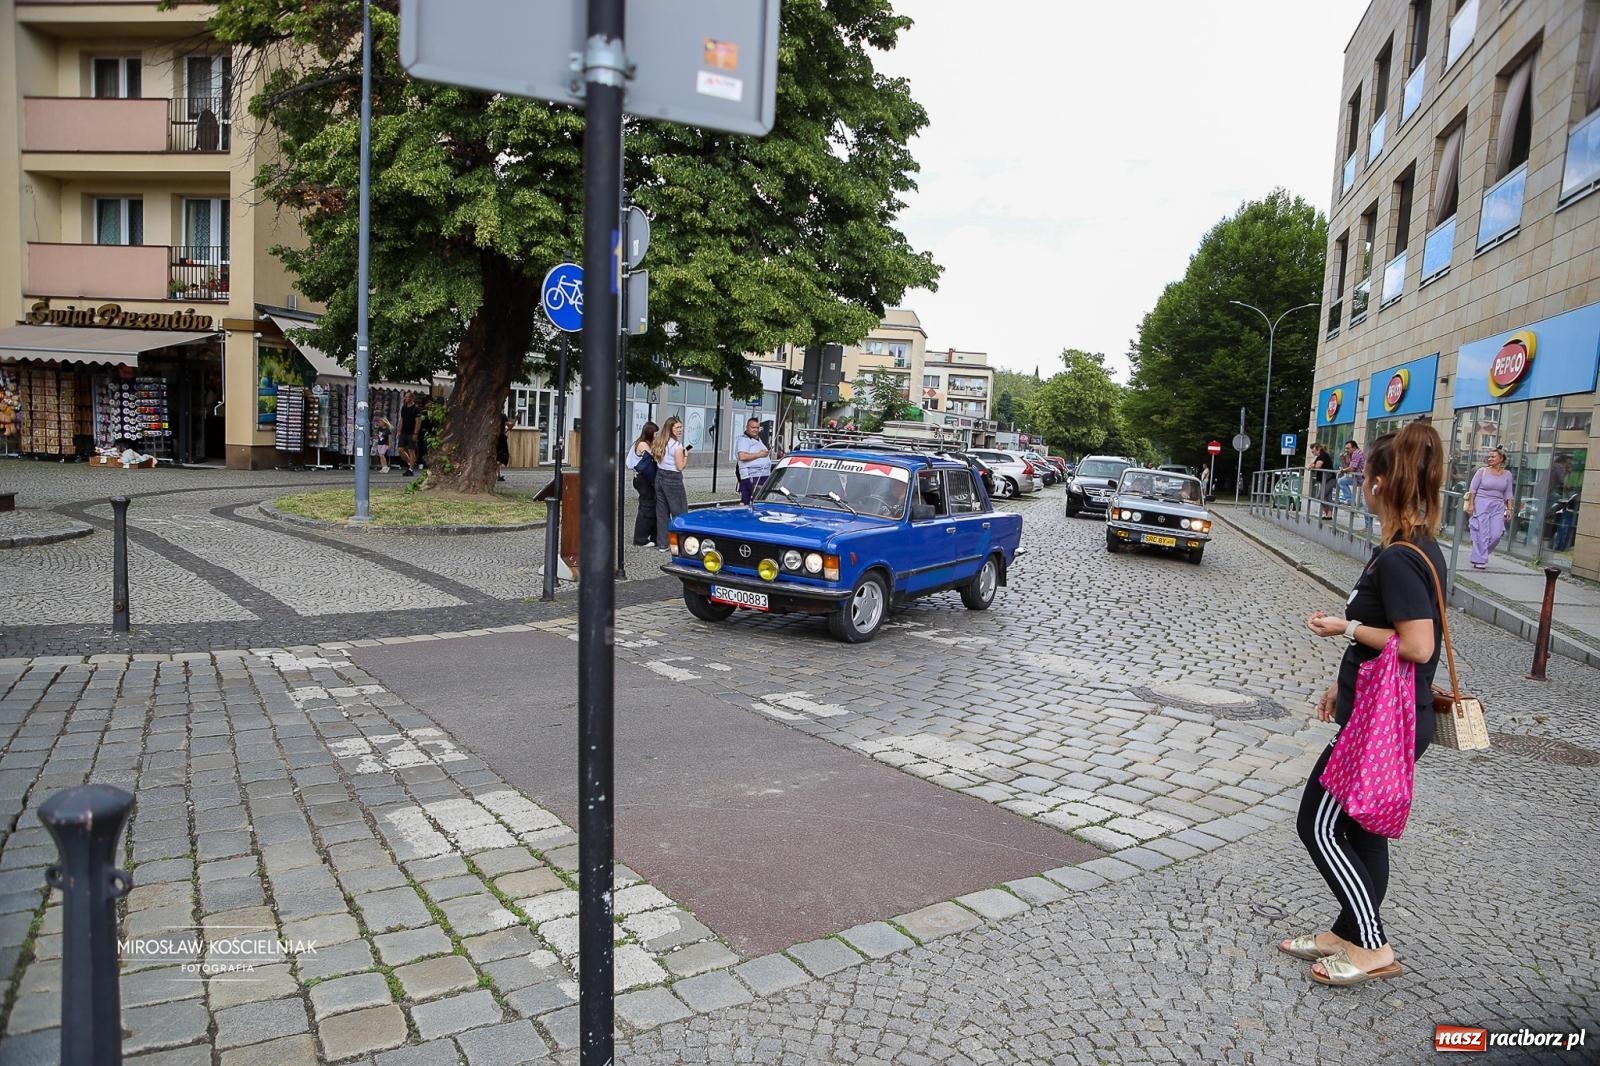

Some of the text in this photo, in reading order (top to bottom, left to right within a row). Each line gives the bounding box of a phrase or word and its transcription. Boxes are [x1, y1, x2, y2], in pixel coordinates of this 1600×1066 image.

[97, 303, 213, 330] Prezentów
[1494, 352, 1524, 376] PEPCO
[1285, 436, 1294, 447] P
[812, 459, 863, 473] Marlboro
[715, 586, 768, 606] SRC 00883
